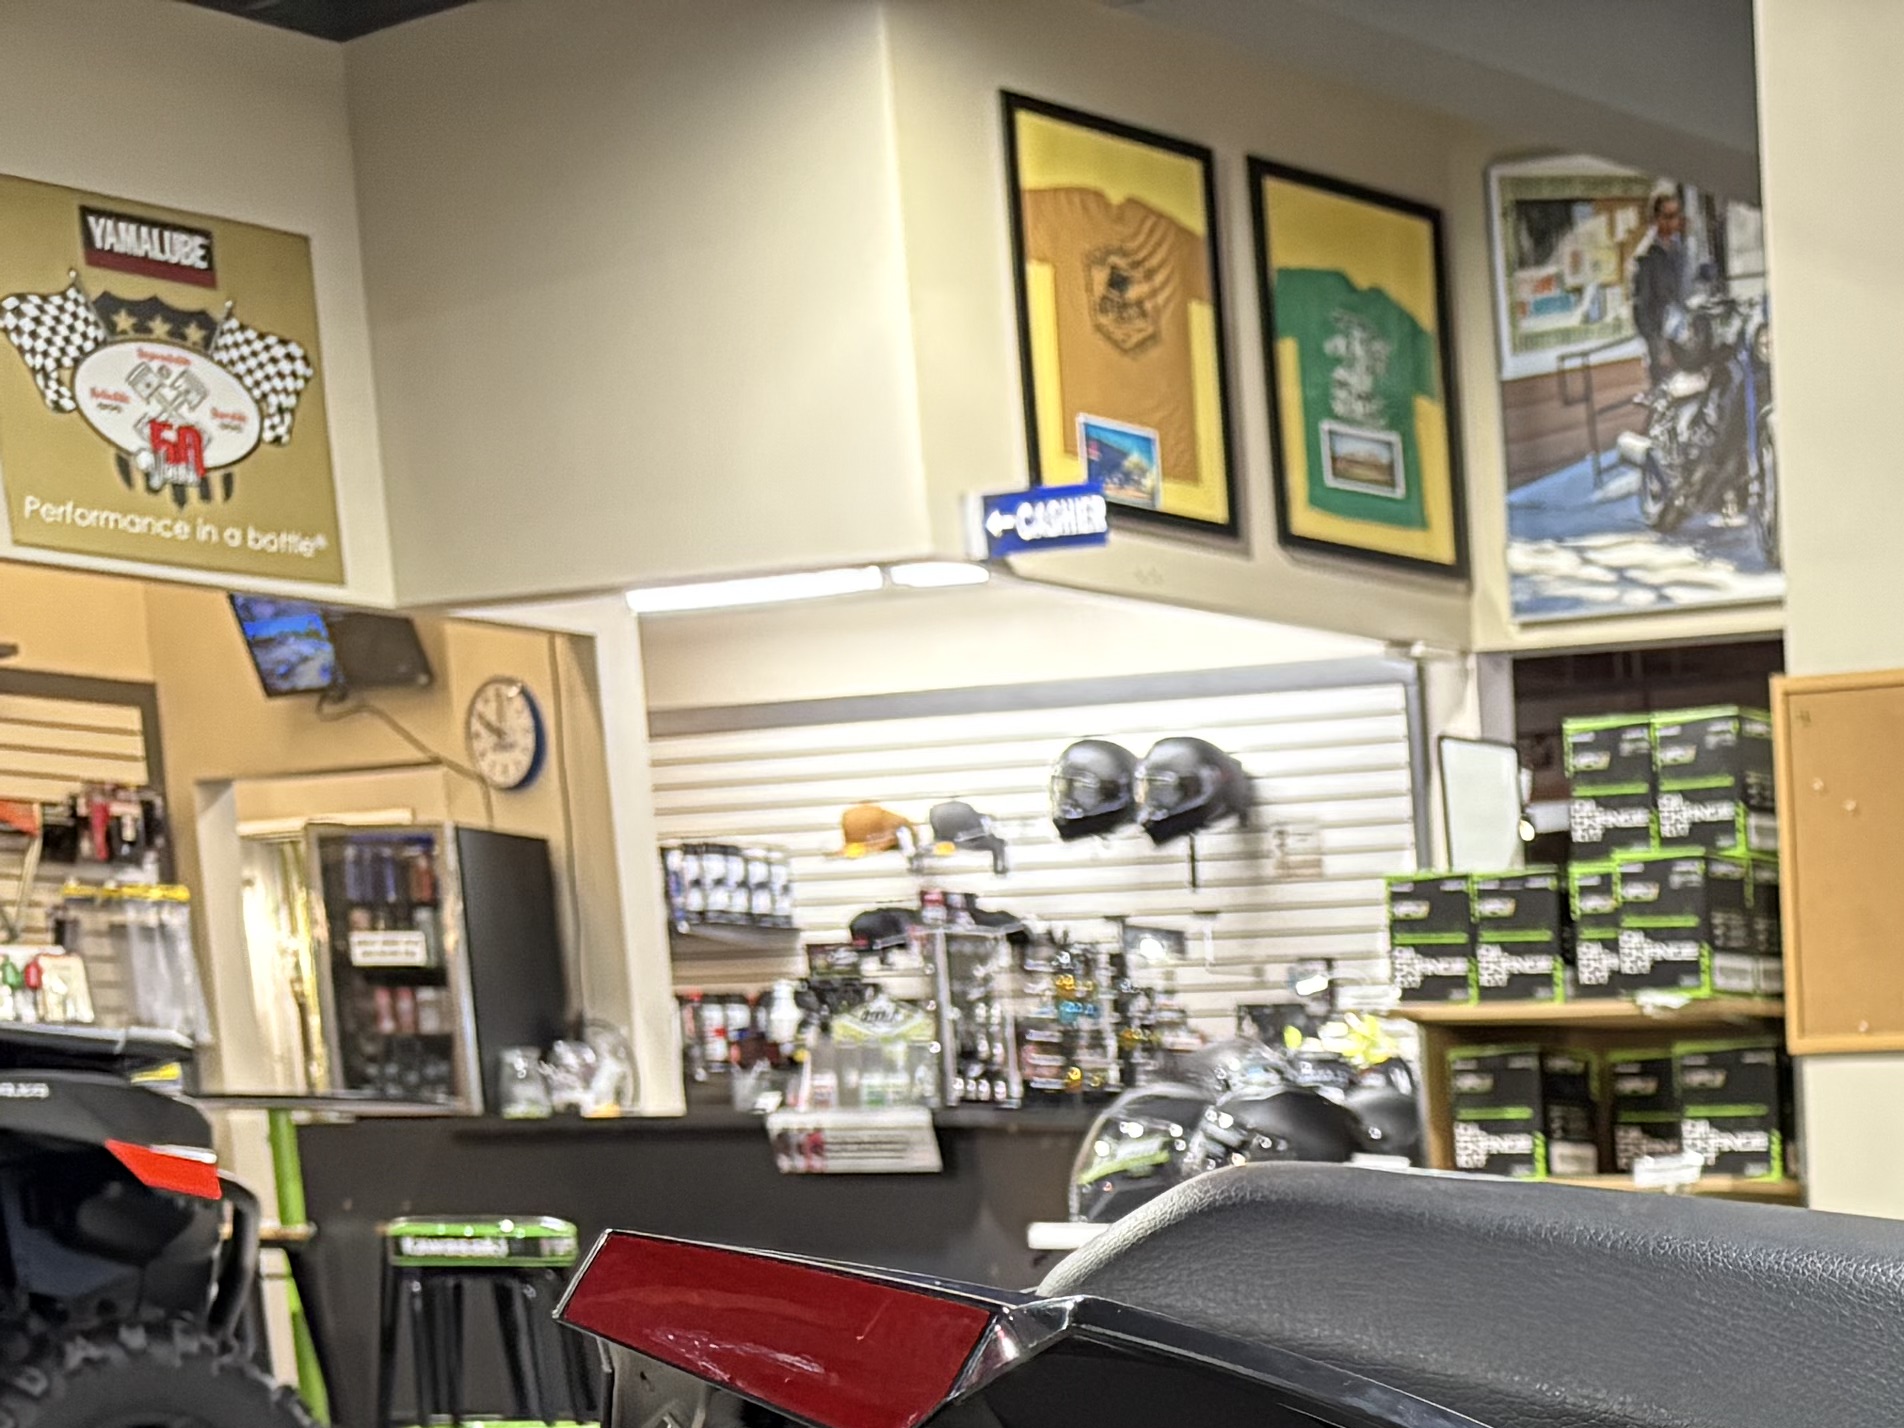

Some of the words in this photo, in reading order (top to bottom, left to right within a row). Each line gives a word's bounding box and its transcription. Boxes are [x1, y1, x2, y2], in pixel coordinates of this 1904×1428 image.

[86, 215, 209, 269] YAMALUBE
[24, 496, 190, 540] Performance
[196, 518, 218, 540] in
[224, 527, 241, 548] a
